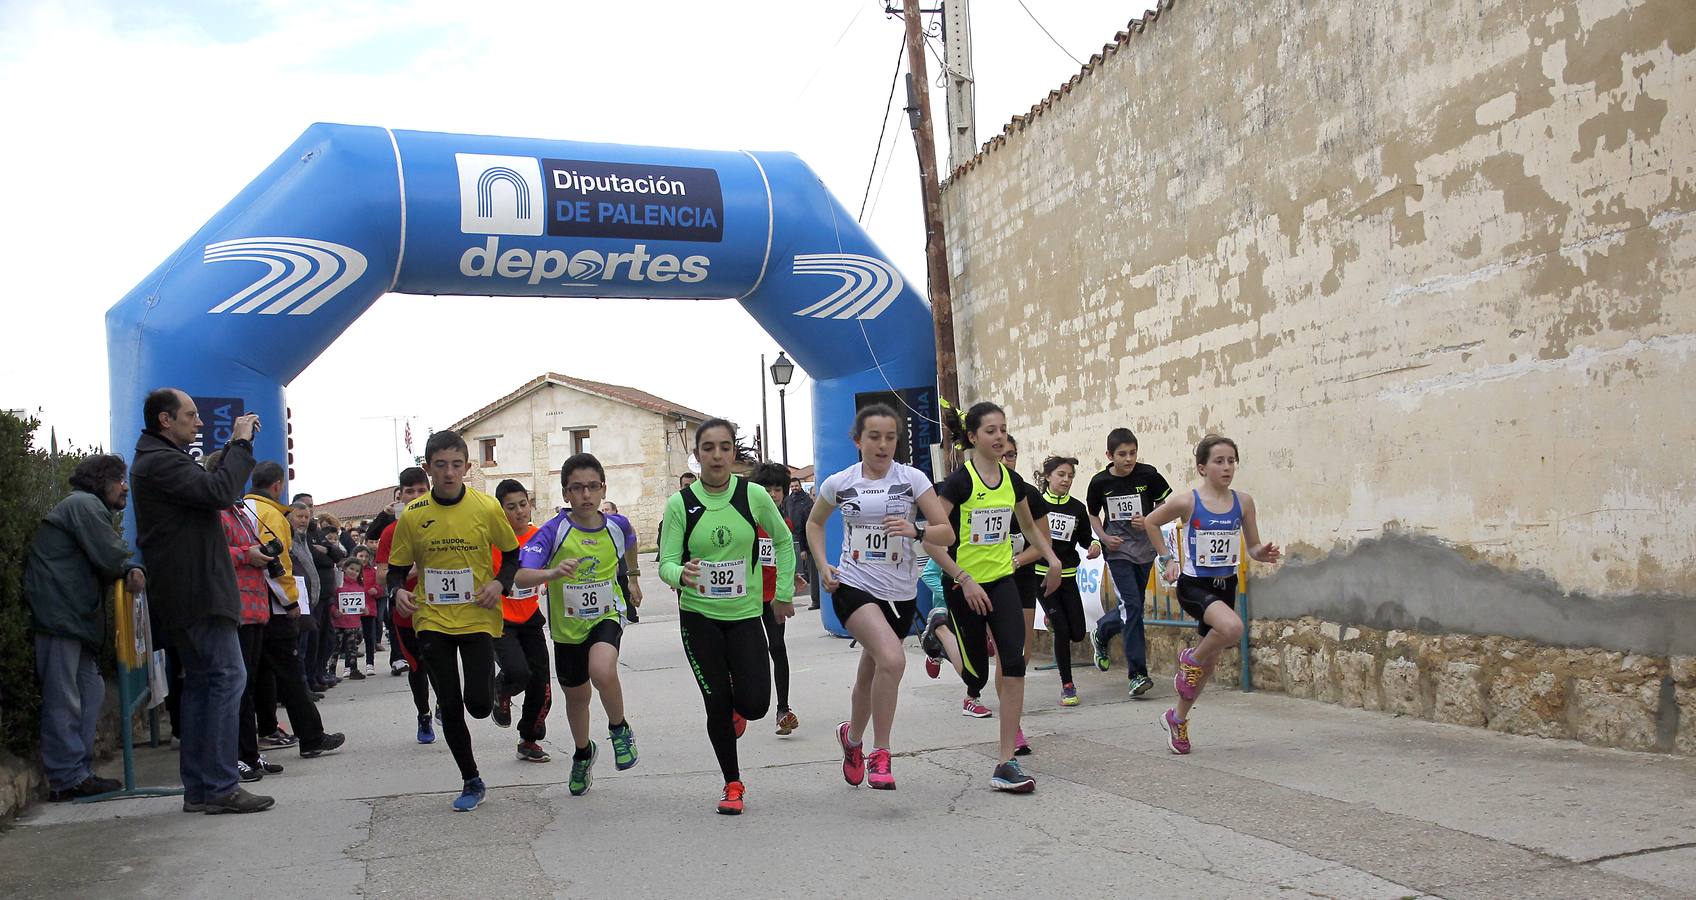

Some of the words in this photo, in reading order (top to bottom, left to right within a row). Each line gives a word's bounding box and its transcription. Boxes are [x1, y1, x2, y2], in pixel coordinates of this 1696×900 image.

[552, 169, 686, 196] Diputación
[556, 200, 590, 223] DE
[599, 202, 718, 229] PALENCIA
[459, 236, 711, 286] deportes
[1117, 502, 1133, 512] 136
[985, 517, 1002, 531] 175
[1050, 519, 1066, 531] 135
[865, 533, 888, 549] 101
[1210, 539, 1230, 553] 321
[441, 577, 456, 592] 31
[710, 570, 734, 585] 382
[342, 597, 362, 606] 372
[582, 591, 597, 607] 36
